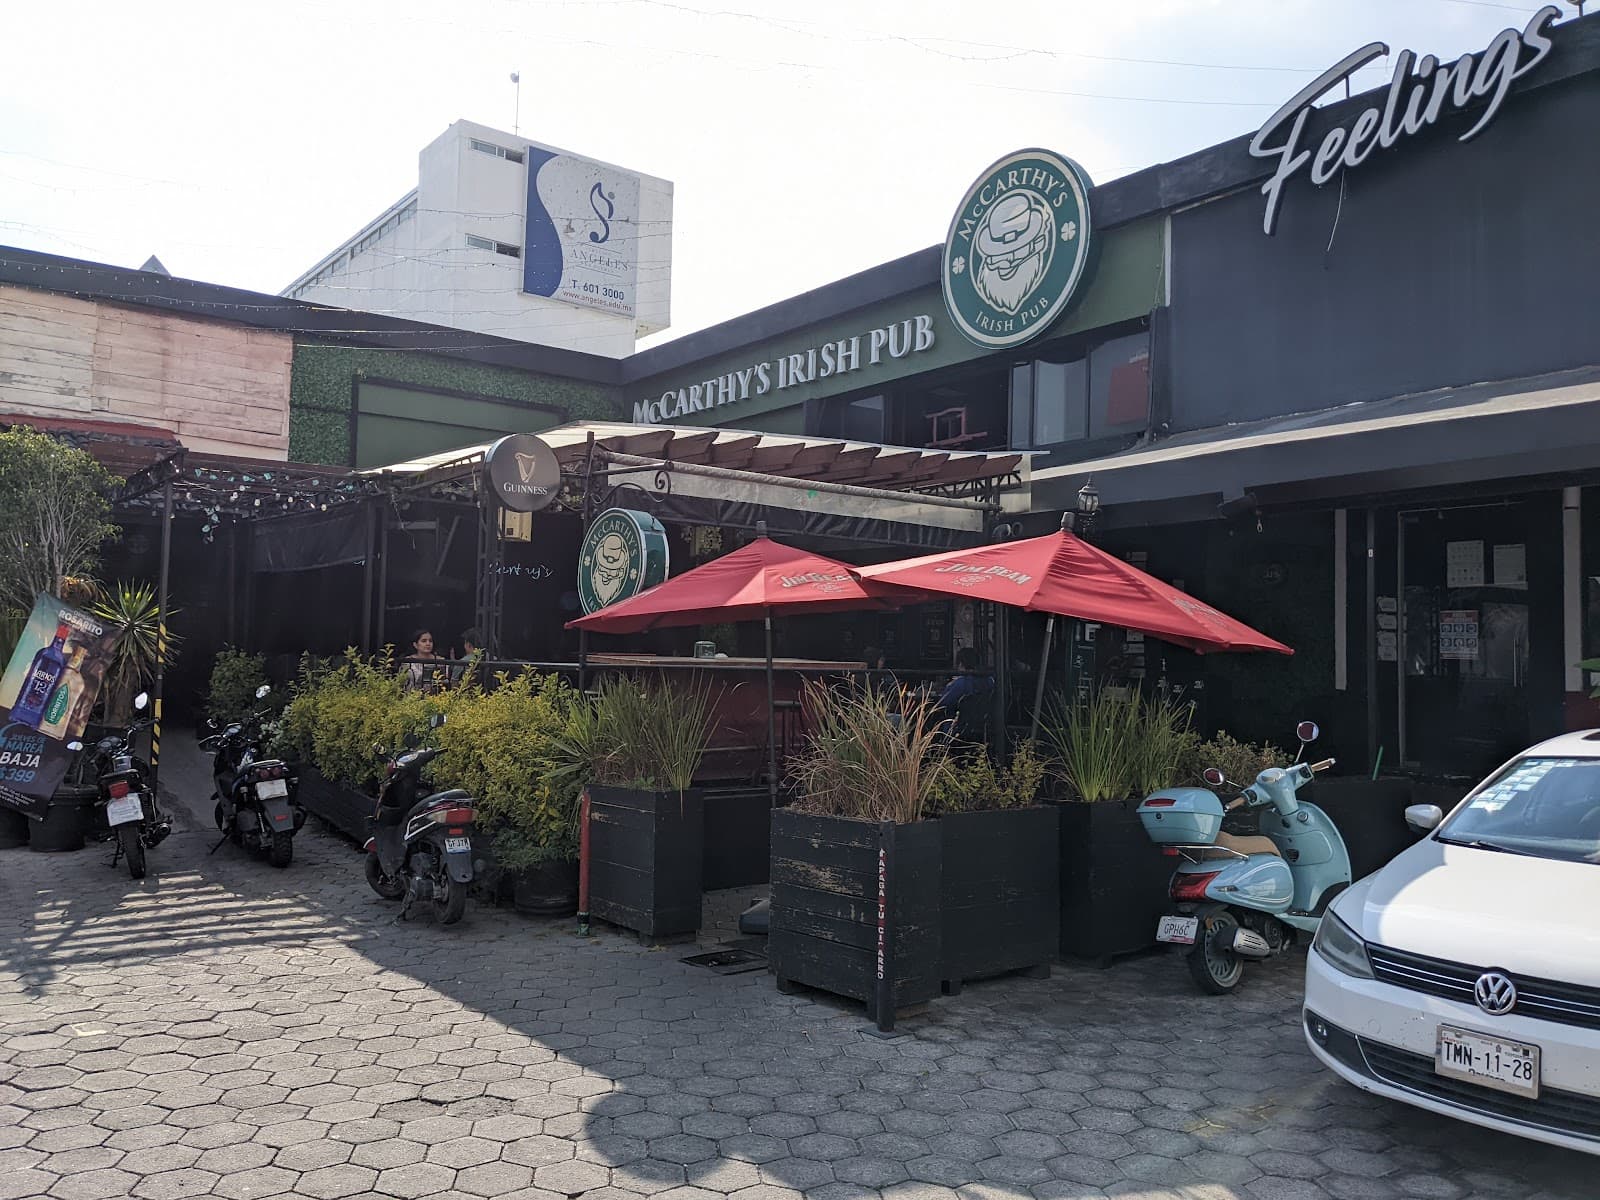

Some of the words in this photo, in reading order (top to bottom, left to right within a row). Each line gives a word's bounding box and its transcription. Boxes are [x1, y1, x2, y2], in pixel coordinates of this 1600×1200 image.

[1249, 4, 1563, 236] Feelings
[958, 167, 1068, 241] McCARTHY'S
[570, 248, 631, 272] ANGELES
[562, 289, 632, 312] www.angeles.edu.mx
[583, 282, 599, 294] 601
[602, 287, 624, 300] 3000
[975, 311, 1014, 332] IRISH
[1021, 297, 1049, 326] PUB
[633, 361, 771, 424] McCARTHY'S
[777, 336, 861, 389] IRISH
[869, 314, 936, 365] PUB
[503, 482, 548, 496] GUINNESS
[590, 520, 638, 557] McCARTHY'S
[934, 563, 985, 573] JIM
[984, 565, 1032, 585] BEAM
[58, 609, 103, 636] ROSARITO
[32, 668, 56, 683] LARIOS
[5, 740, 45, 753] MAREA
[0, 751, 41, 768] BAJA
[1444, 1040, 1533, 1081] TMN-11-28
